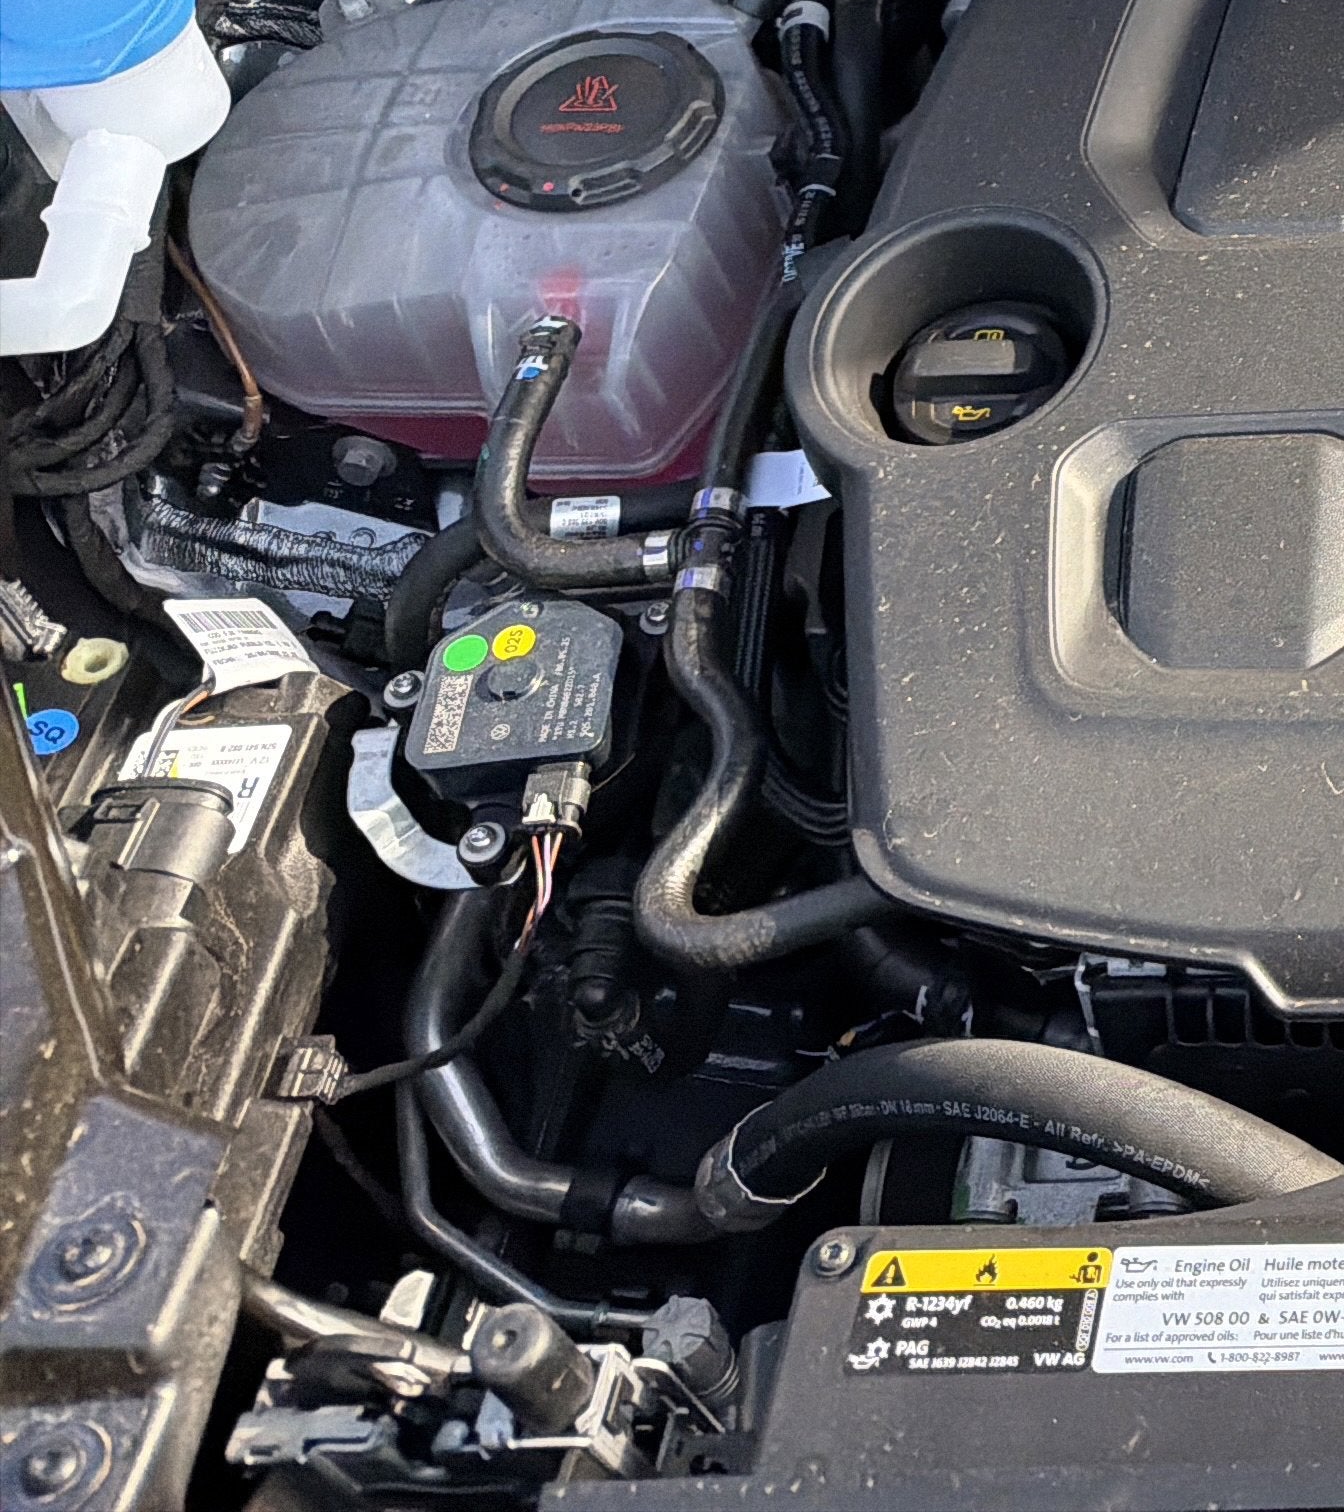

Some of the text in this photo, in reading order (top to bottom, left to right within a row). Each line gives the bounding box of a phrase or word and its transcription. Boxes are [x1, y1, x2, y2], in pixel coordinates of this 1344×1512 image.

[28, 721, 66, 745] SQ
[237, 777, 260, 799] R
[943, 1100, 971, 1118] SAE
[974, 1105, 1030, 1129] J2064-E
[1044, 1120, 1066, 1137] All
[1174, 1258, 1251, 1276] Engine Oil
[1264, 1257, 1303, 1271] Huile
[1115, 1277, 1247, 1290] Use only oil that expressly
[1261, 1277, 1300, 1288] Utilisez
[1113, 1290, 1185, 1304] complies with
[1259, 1291, 1277, 1304] qui
[1279, 1289, 1320, 1301] satisfait
[905, 1294, 974, 1315] R-1234yf
[1005, 1296, 1045, 1310] 0.460
[1046, 1295, 1064, 1313] kg
[1162, 1312, 1191, 1326] VW
[1194, 1311, 1224, 1326] 508
[1228, 1311, 1250, 1325] 00
[1258, 1312, 1270, 1324] &
[1278, 1310, 1309, 1325] SAE
[1105, 1330, 1239, 1344] For a list of approved oils:
[1253, 1330, 1277, 1341] Pour
[1279, 1330, 1299, 1340] une
[1301, 1329, 1323, 1340] liste
[895, 1339, 930, 1356] PAG
[908, 1357, 930, 1369] SAE
[1033, 1352, 1061, 1367] VW
[1061, 1351, 1086, 1366] AG
[1124, 1354, 1194, 1365] www.vw.com
[1220, 1351, 1300, 1363] 1-800-822-8987
